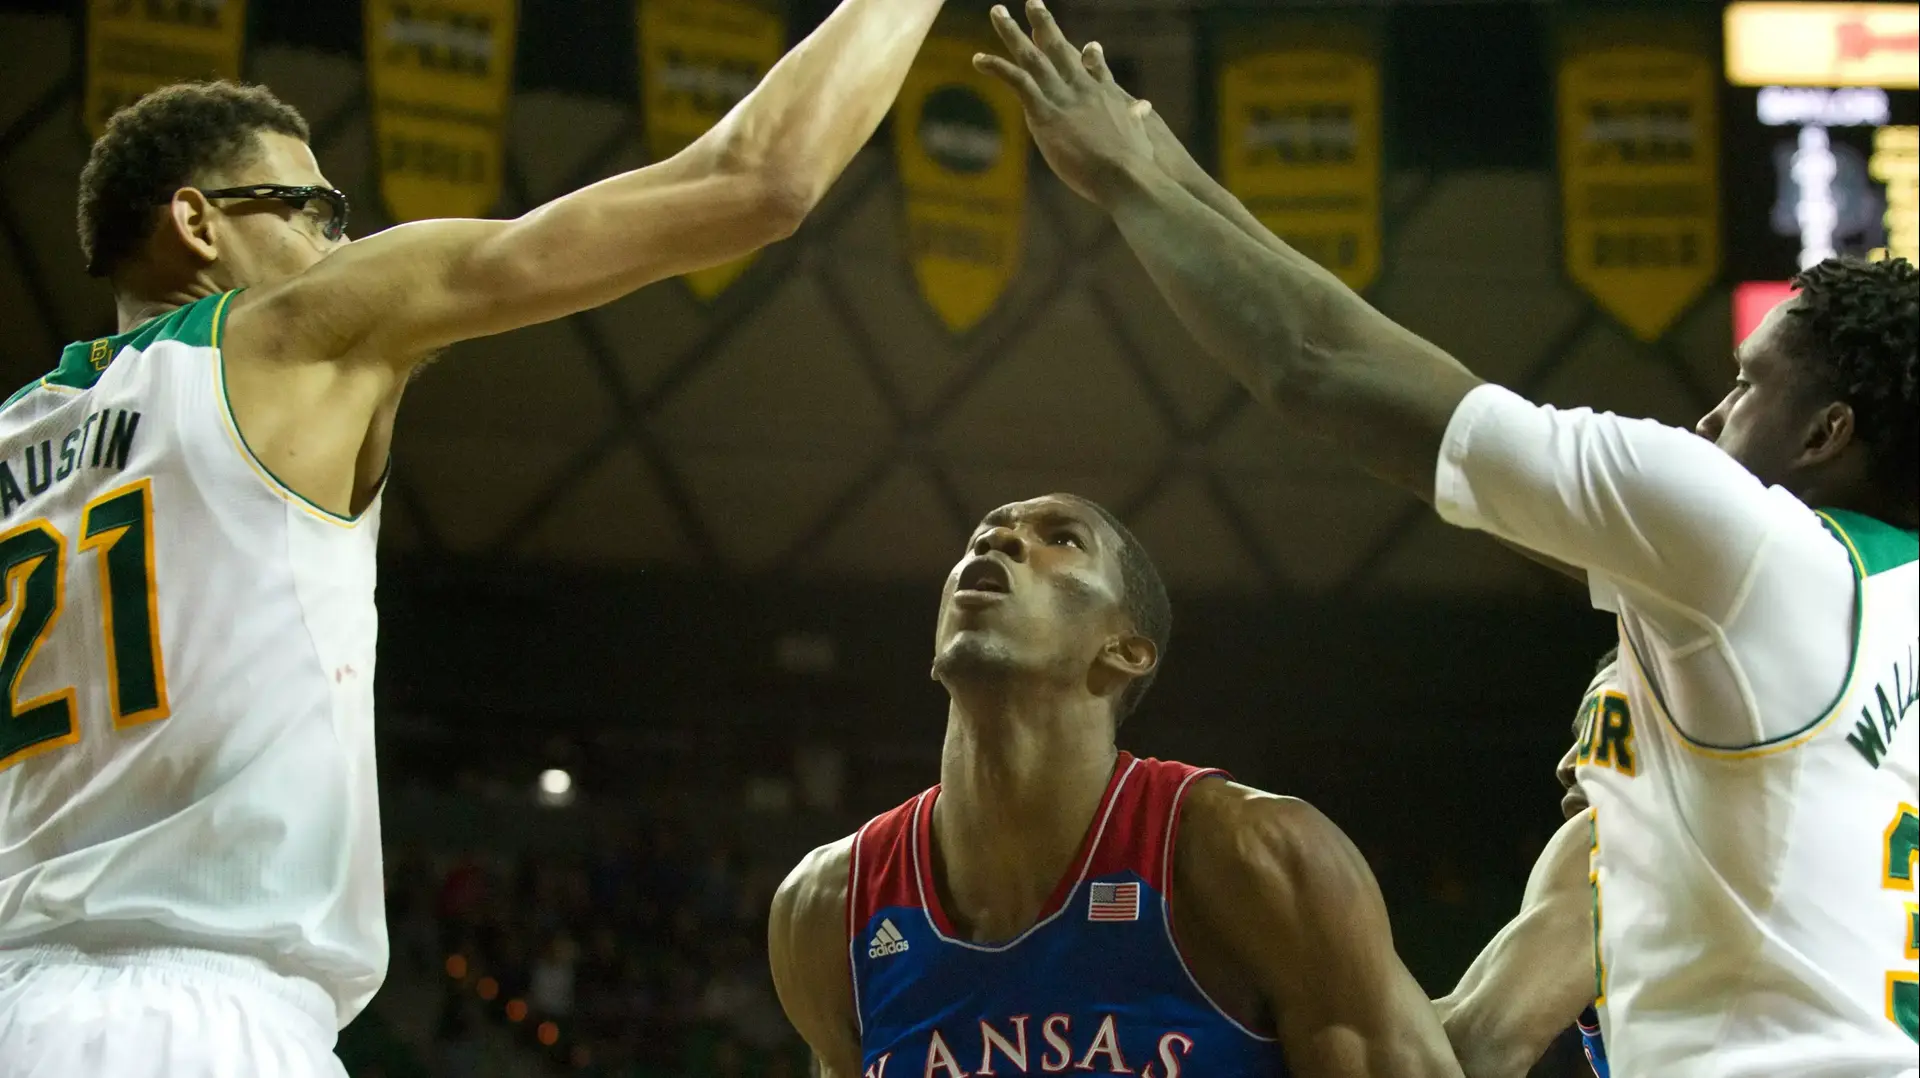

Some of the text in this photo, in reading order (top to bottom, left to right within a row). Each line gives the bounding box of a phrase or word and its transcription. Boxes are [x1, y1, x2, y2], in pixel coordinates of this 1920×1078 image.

[0, 408, 141, 517] AUSTIN
[0, 477, 171, 773] 21
[868, 940, 909, 958] adidas
